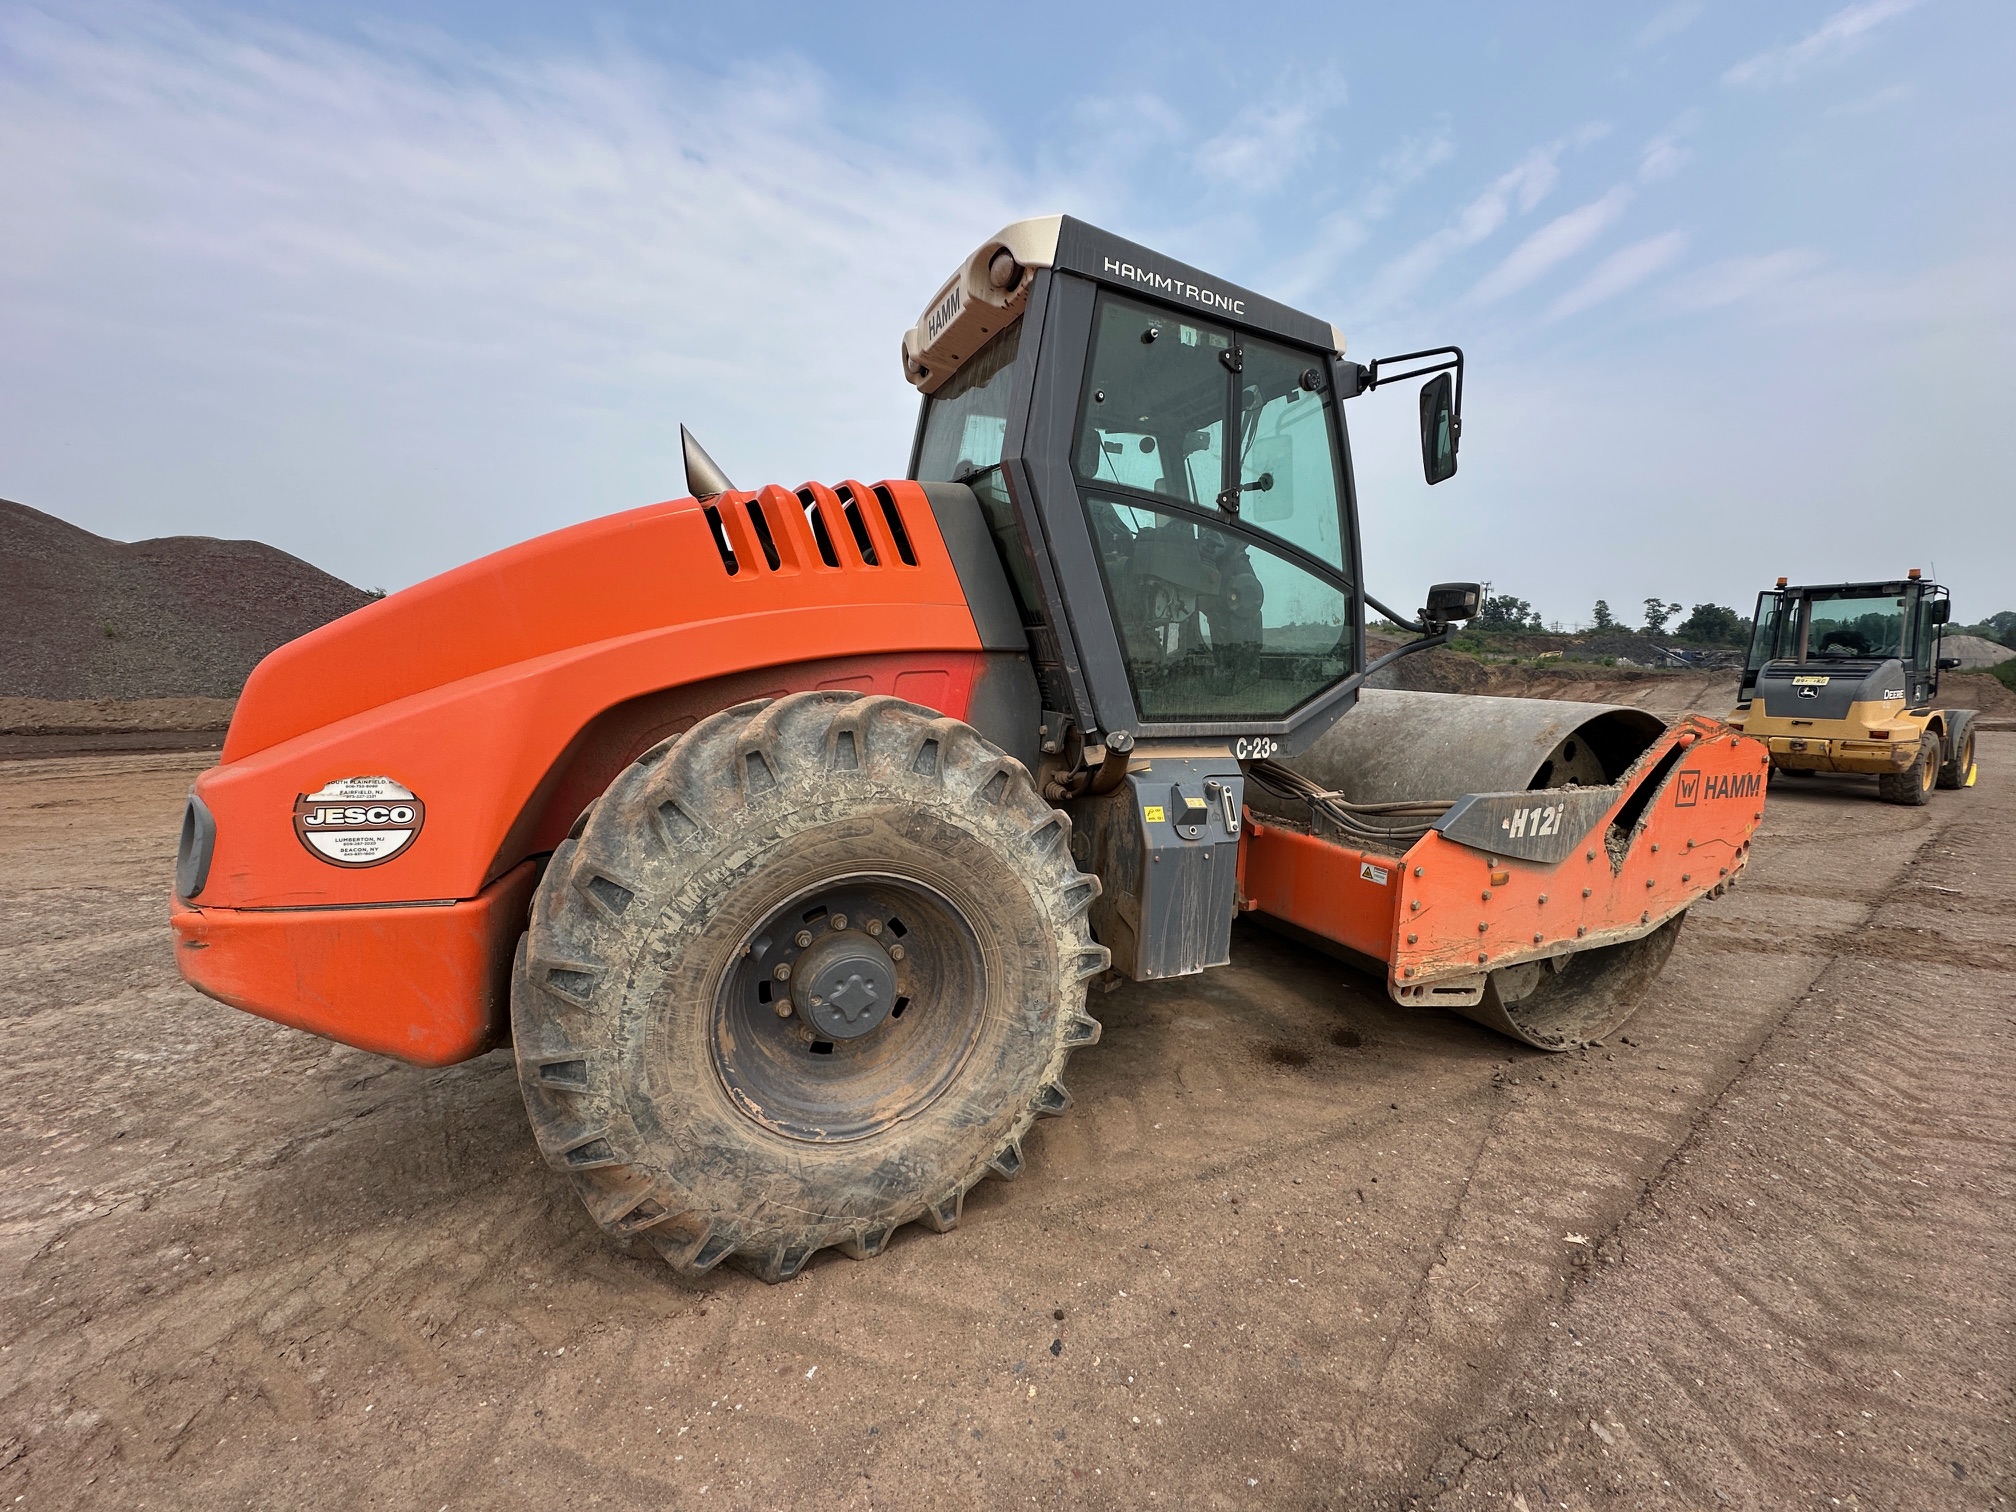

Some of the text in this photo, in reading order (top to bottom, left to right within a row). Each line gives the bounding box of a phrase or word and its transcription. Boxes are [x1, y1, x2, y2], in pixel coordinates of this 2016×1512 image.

[1103, 256, 1245, 315] HAMMTRONIC
[928, 286, 960, 341] HAMM
[1884, 689, 1904, 700] DEERE
[1704, 774, 1761, 799] HAMM
[304, 805, 416, 827] JESCO
[1509, 803, 1564, 838] H12i
